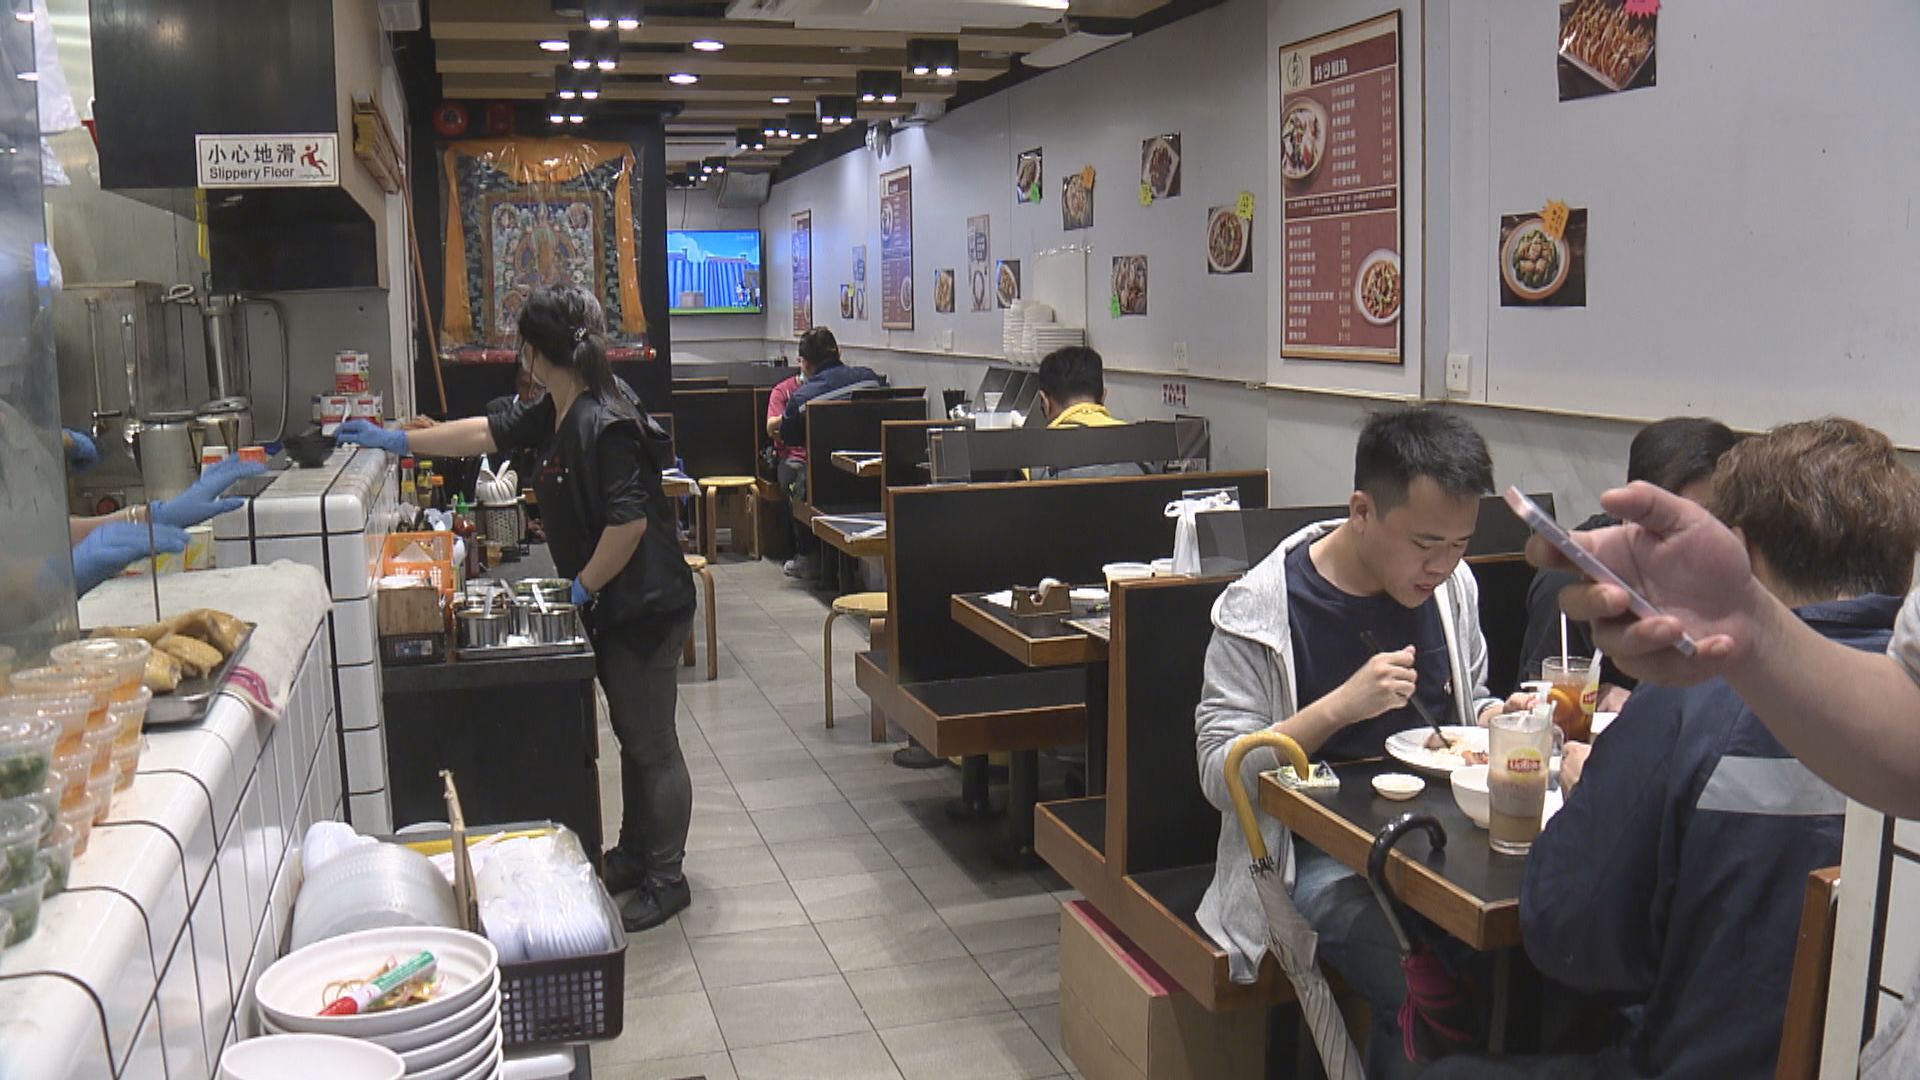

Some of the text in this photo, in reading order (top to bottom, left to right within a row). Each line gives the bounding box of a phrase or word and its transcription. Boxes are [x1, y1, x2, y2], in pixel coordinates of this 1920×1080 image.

[208, 142, 296, 164] 小心地滑
[209, 165, 295, 181] Slippery Floor
